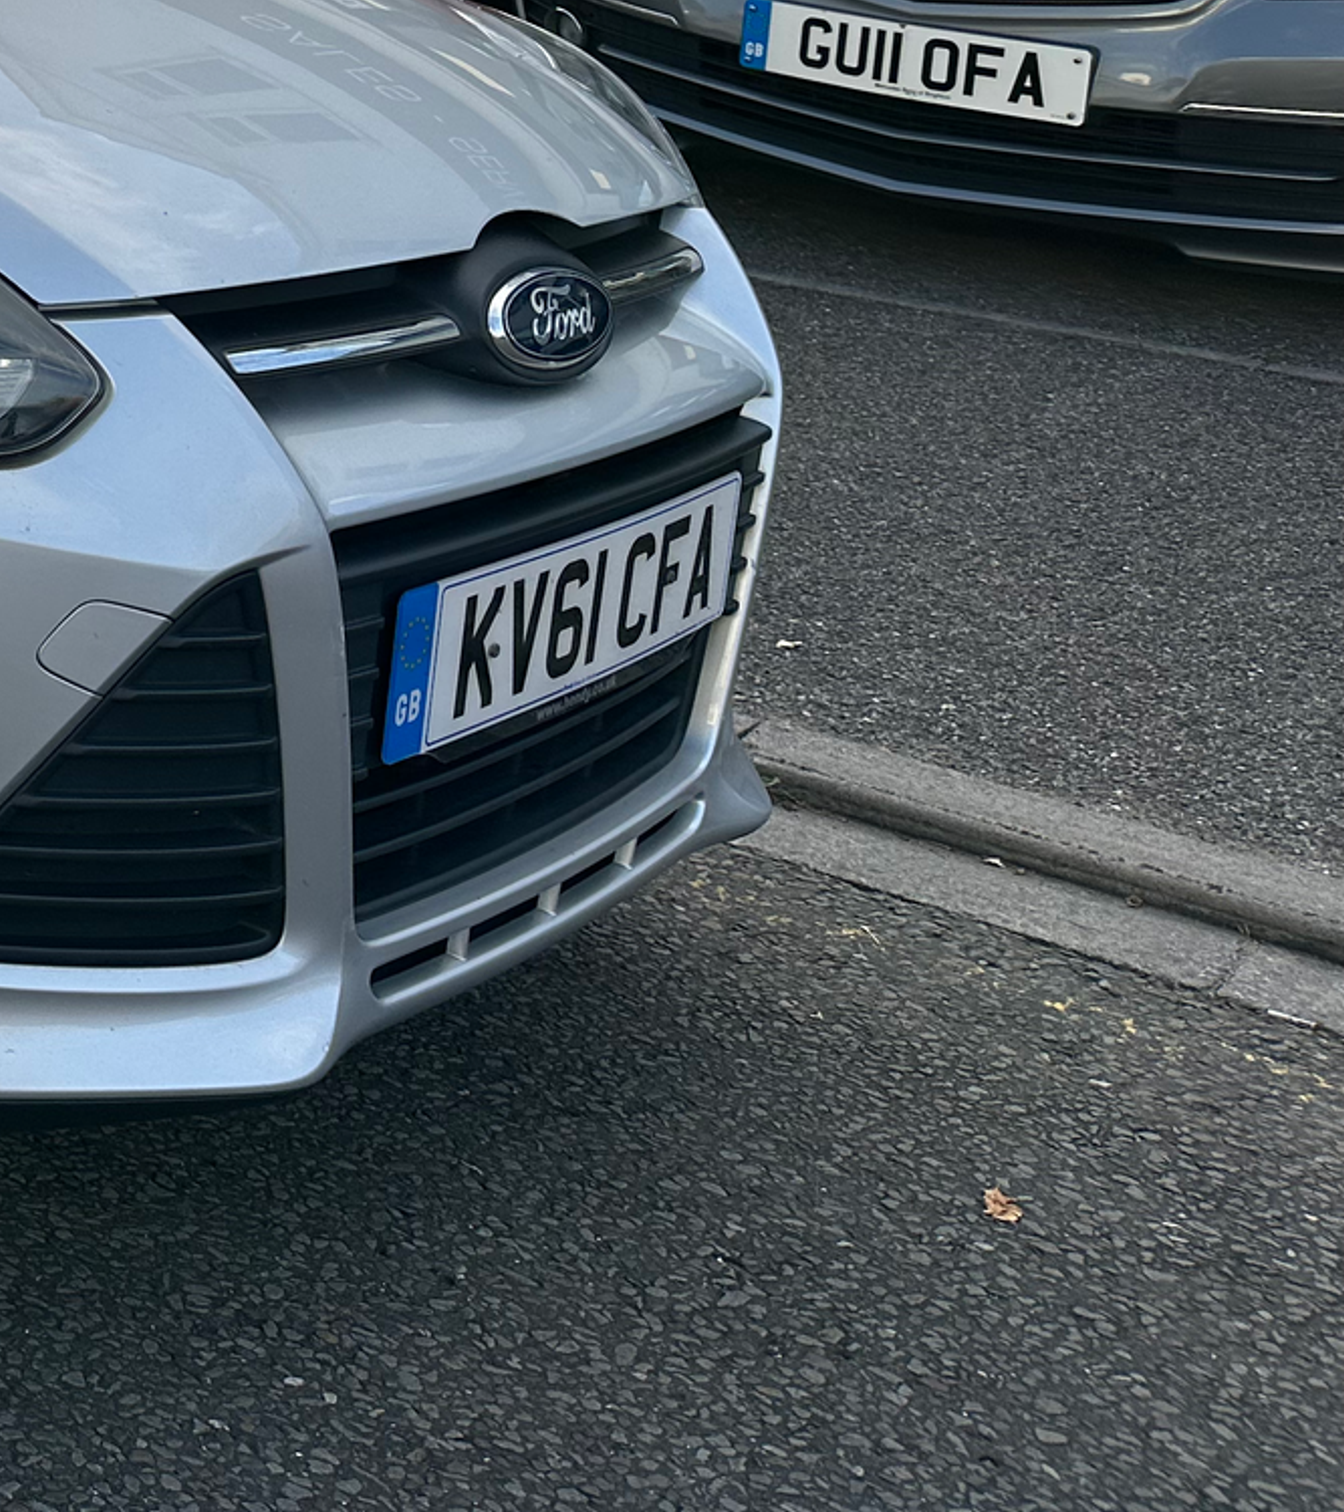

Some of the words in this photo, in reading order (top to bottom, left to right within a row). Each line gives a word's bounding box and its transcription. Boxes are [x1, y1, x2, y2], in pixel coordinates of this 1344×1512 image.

[745, 40, 765, 61] GB
[799, 16, 903, 86] GU11
[920, 37, 1045, 108] OFA
[529, 284, 596, 344] Ford
[452, 546, 608, 720] KV61
[616, 504, 714, 649] CFA
[394, 688, 422, 728] GB
